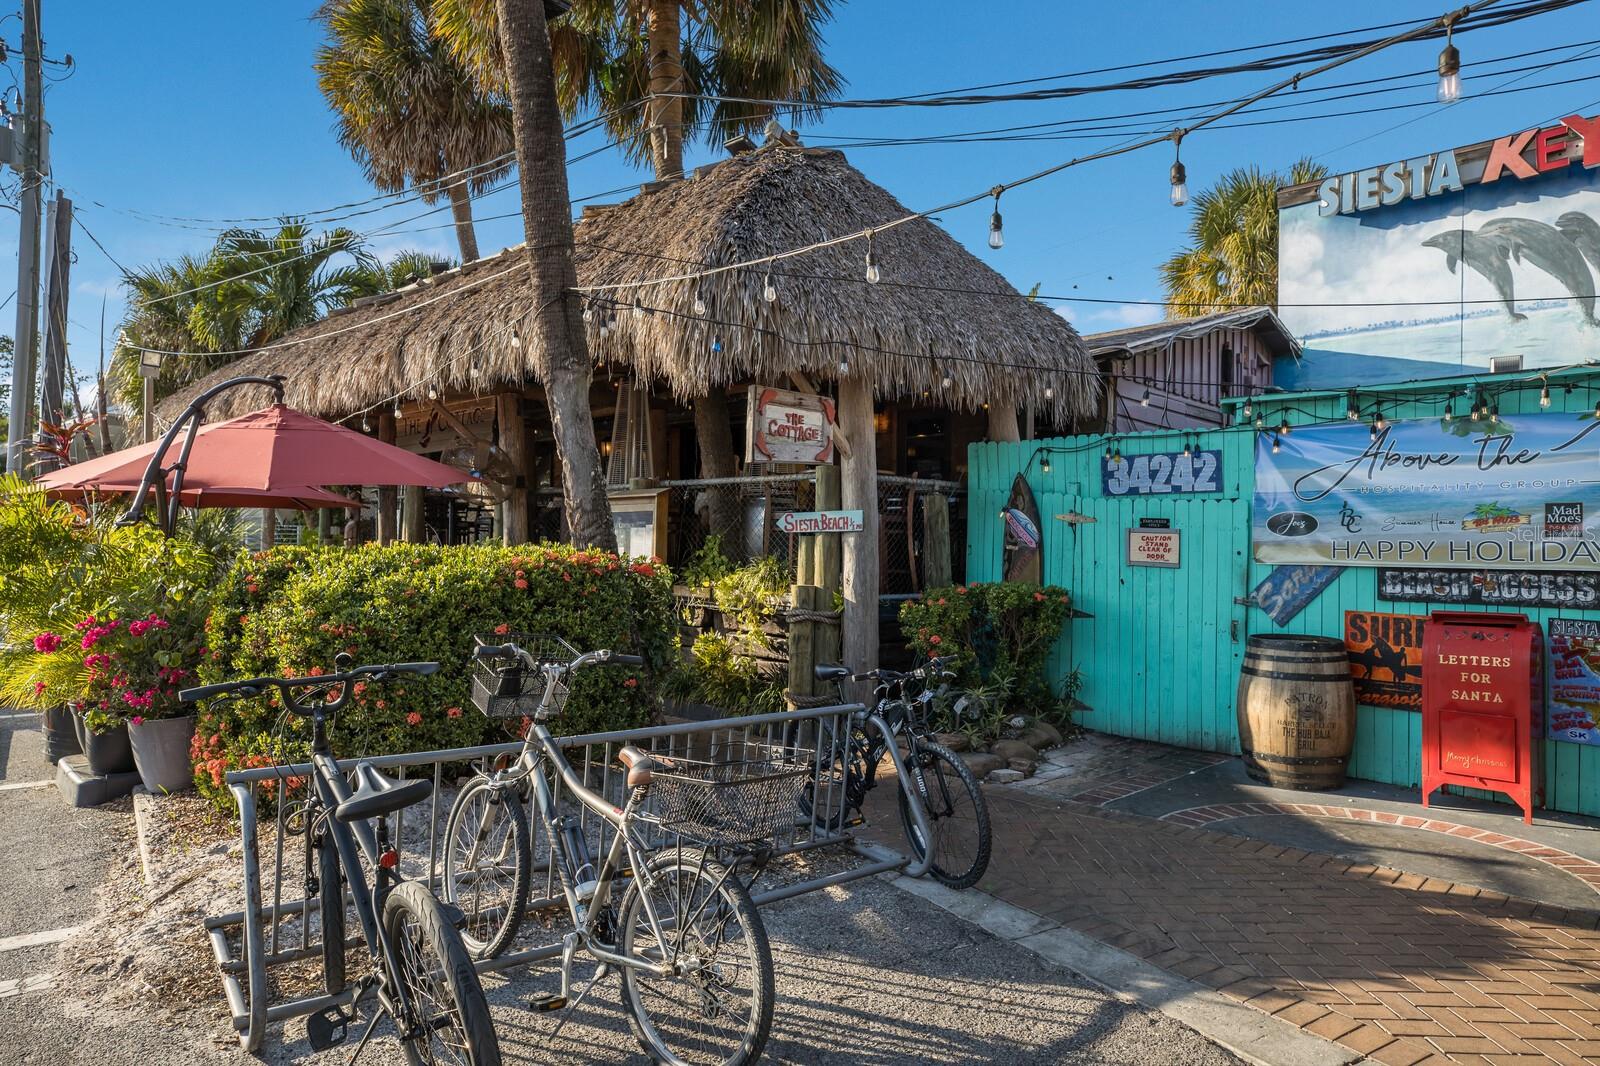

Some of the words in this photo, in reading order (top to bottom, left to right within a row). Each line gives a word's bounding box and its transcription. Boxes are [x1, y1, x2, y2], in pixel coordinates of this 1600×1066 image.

[1319, 149, 1464, 216] SIESTA
[1481, 114, 1600, 184] KEY
[785, 413, 805, 425] THE
[1308, 425, 1459, 499] Above
[1107, 452, 1216, 494] 34242
[1360, 481, 1485, 494] HOSPITALITY
[1499, 478, 1576, 490] GROUP
[1552, 505, 1581, 516] Mad
[1138, 545, 1161, 553] CLEAR
[1331, 540, 1438, 561] HAPPY
[1384, 571, 1470, 596] BEACH
[1481, 573, 1596, 601] ACCESS
[1552, 620, 1600, 637] SIESTA
[1439, 654, 1511, 668] LETTERS
[1461, 672, 1492, 684] FOR
[1451, 689, 1504, 704] SANTA
[1282, 727, 1296, 738] THE
[1569, 730, 1587, 740] SK
